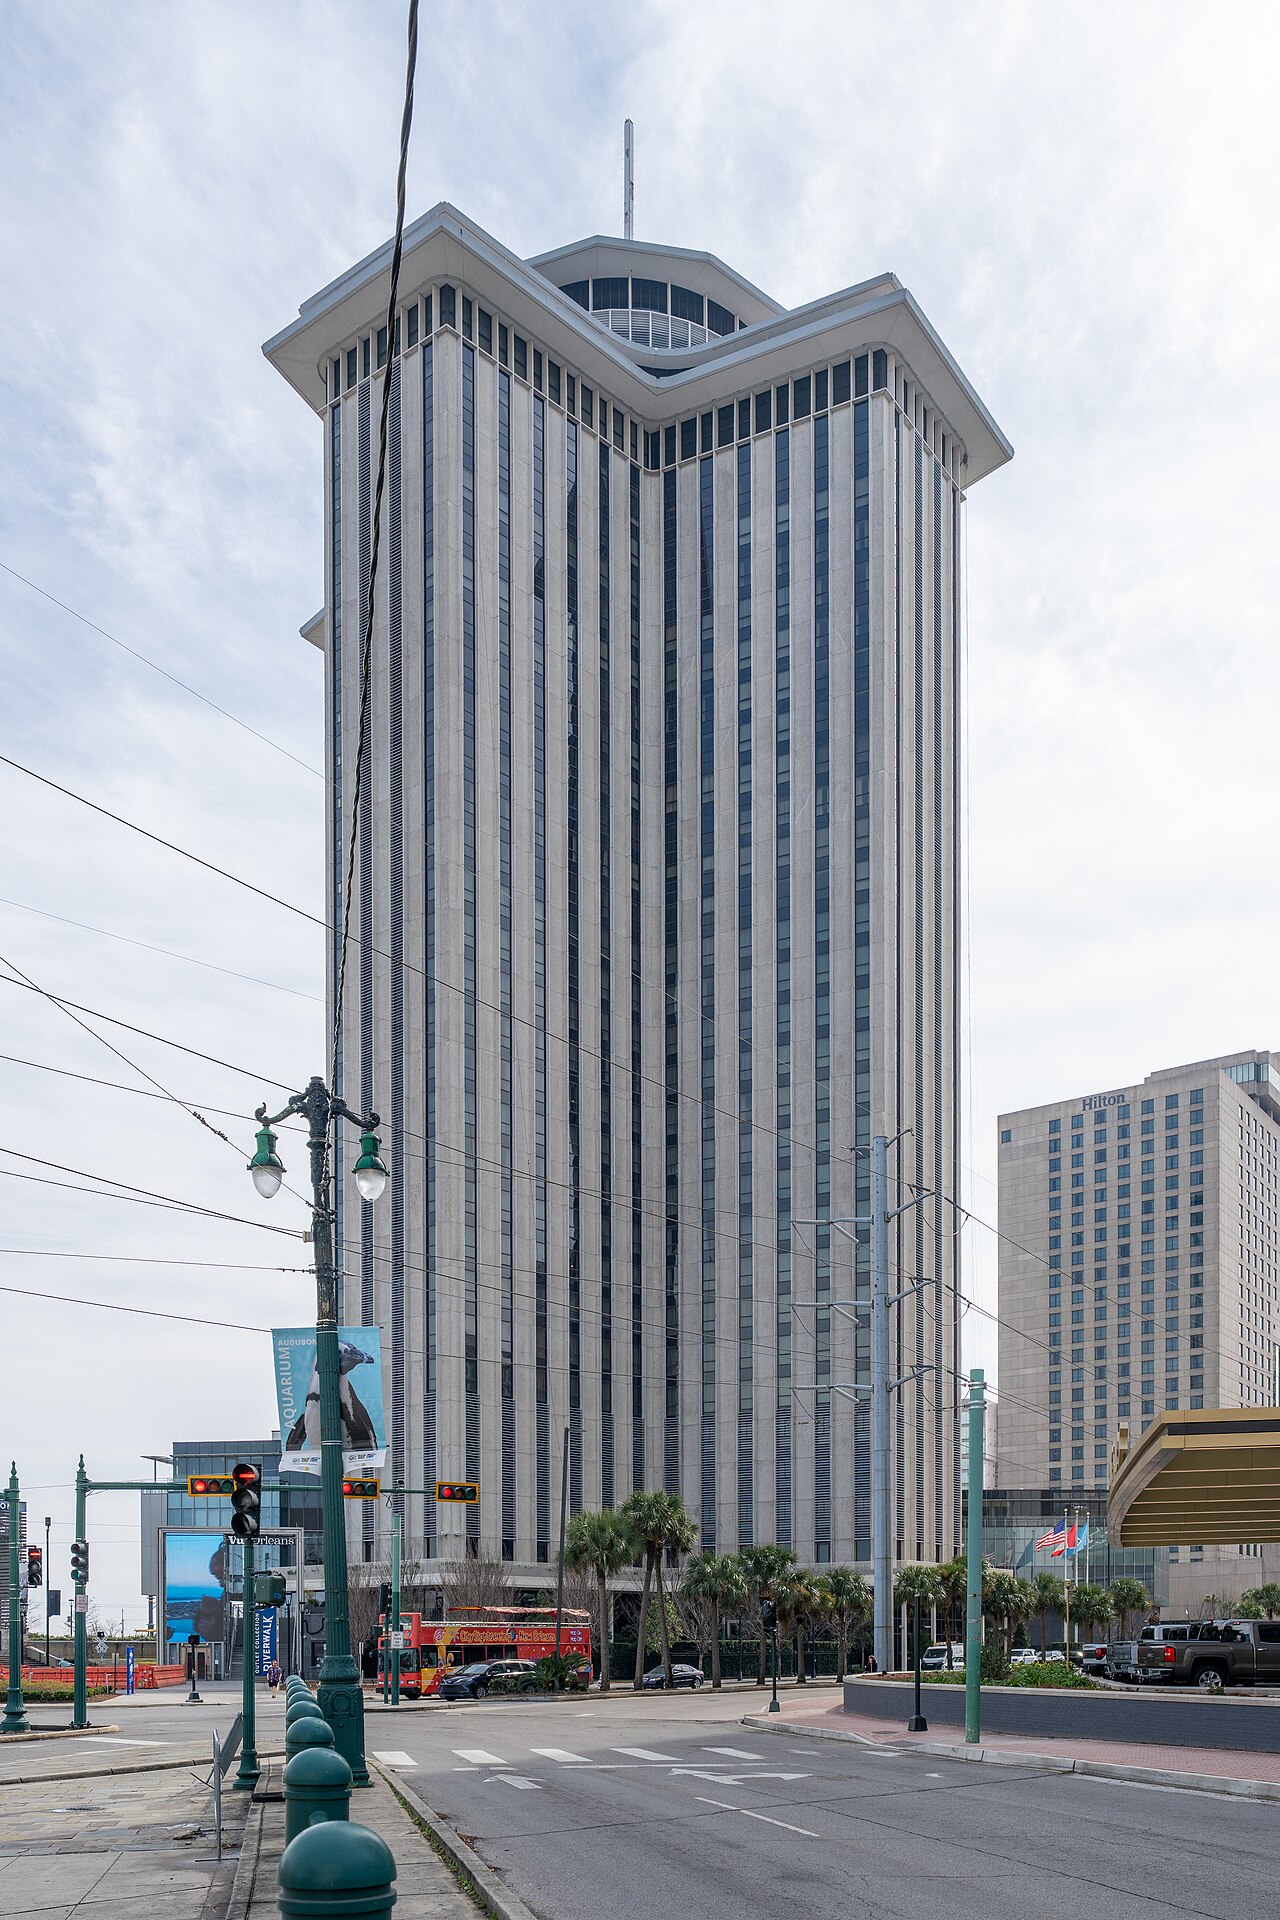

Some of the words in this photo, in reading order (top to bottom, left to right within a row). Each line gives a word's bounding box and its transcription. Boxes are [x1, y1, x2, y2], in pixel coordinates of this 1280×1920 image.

[1082, 1093, 1126, 1111] Hilton
[278, 1347, 297, 1430] AQUARIUM
[262, 1614, 275, 1672] RIVERWALK
[519, 1630, 532, 1641] New
[533, 1629, 556, 1641] Orleans
